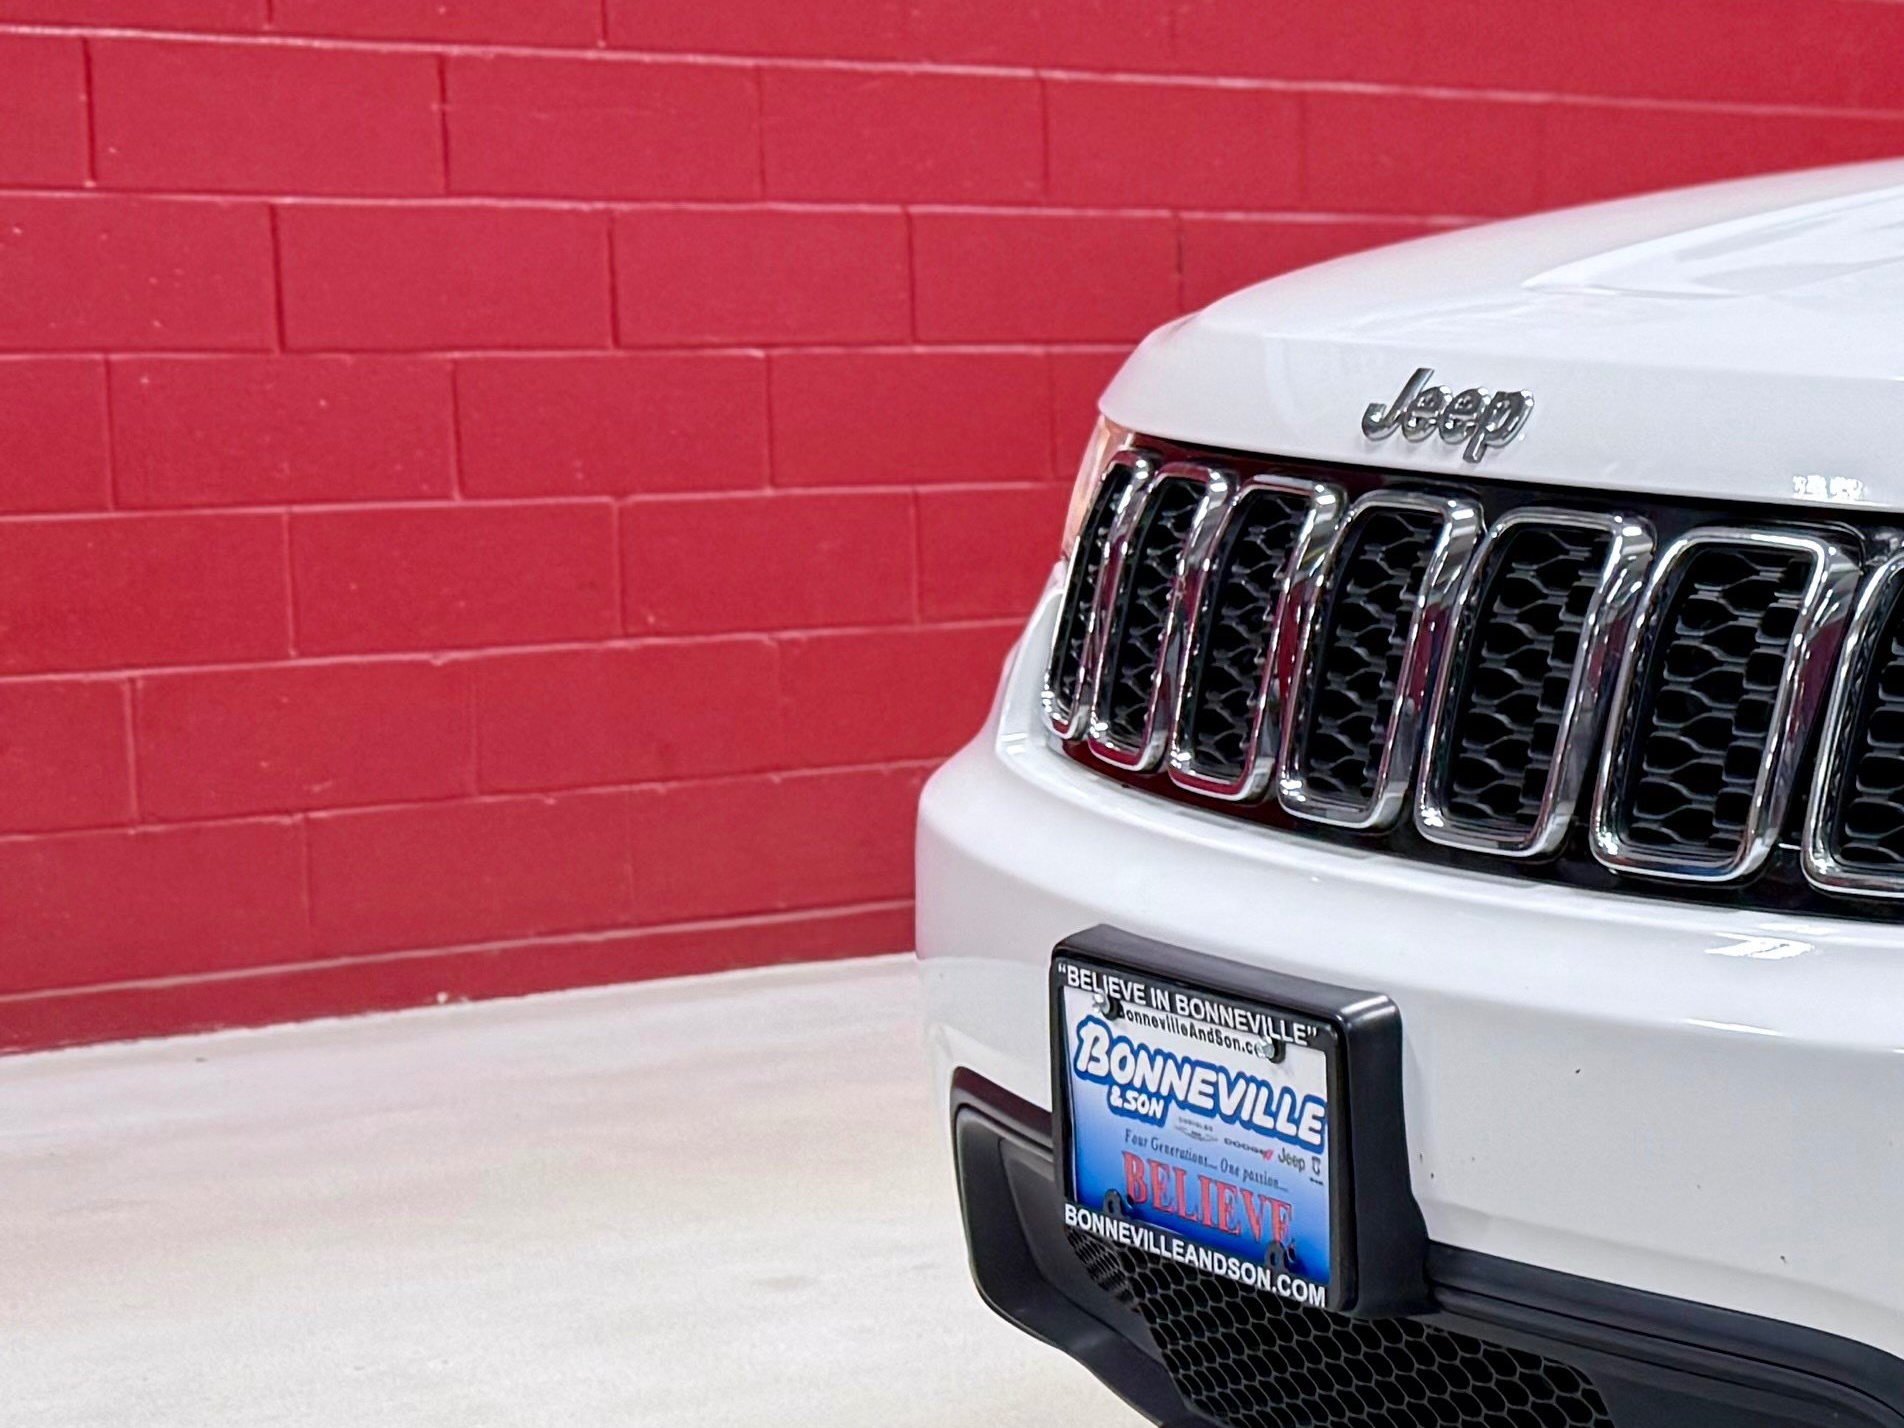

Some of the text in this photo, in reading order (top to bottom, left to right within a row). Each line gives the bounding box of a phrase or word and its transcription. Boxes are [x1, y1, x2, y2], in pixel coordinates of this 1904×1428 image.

[1361, 367, 1535, 464] Jeep
[1150, 987, 1171, 1012] IN
[1076, 1020, 1325, 1146] BONNEVILLE
[1121, 1150, 1294, 1248] BELIEVE
[1125, 1128, 1148, 1148] Four
[1220, 1157, 1239, 1177] One
[1278, 1147, 1306, 1173] Jeep
[1064, 1203, 1326, 1308] BONNEVILLEANDSON.COM
